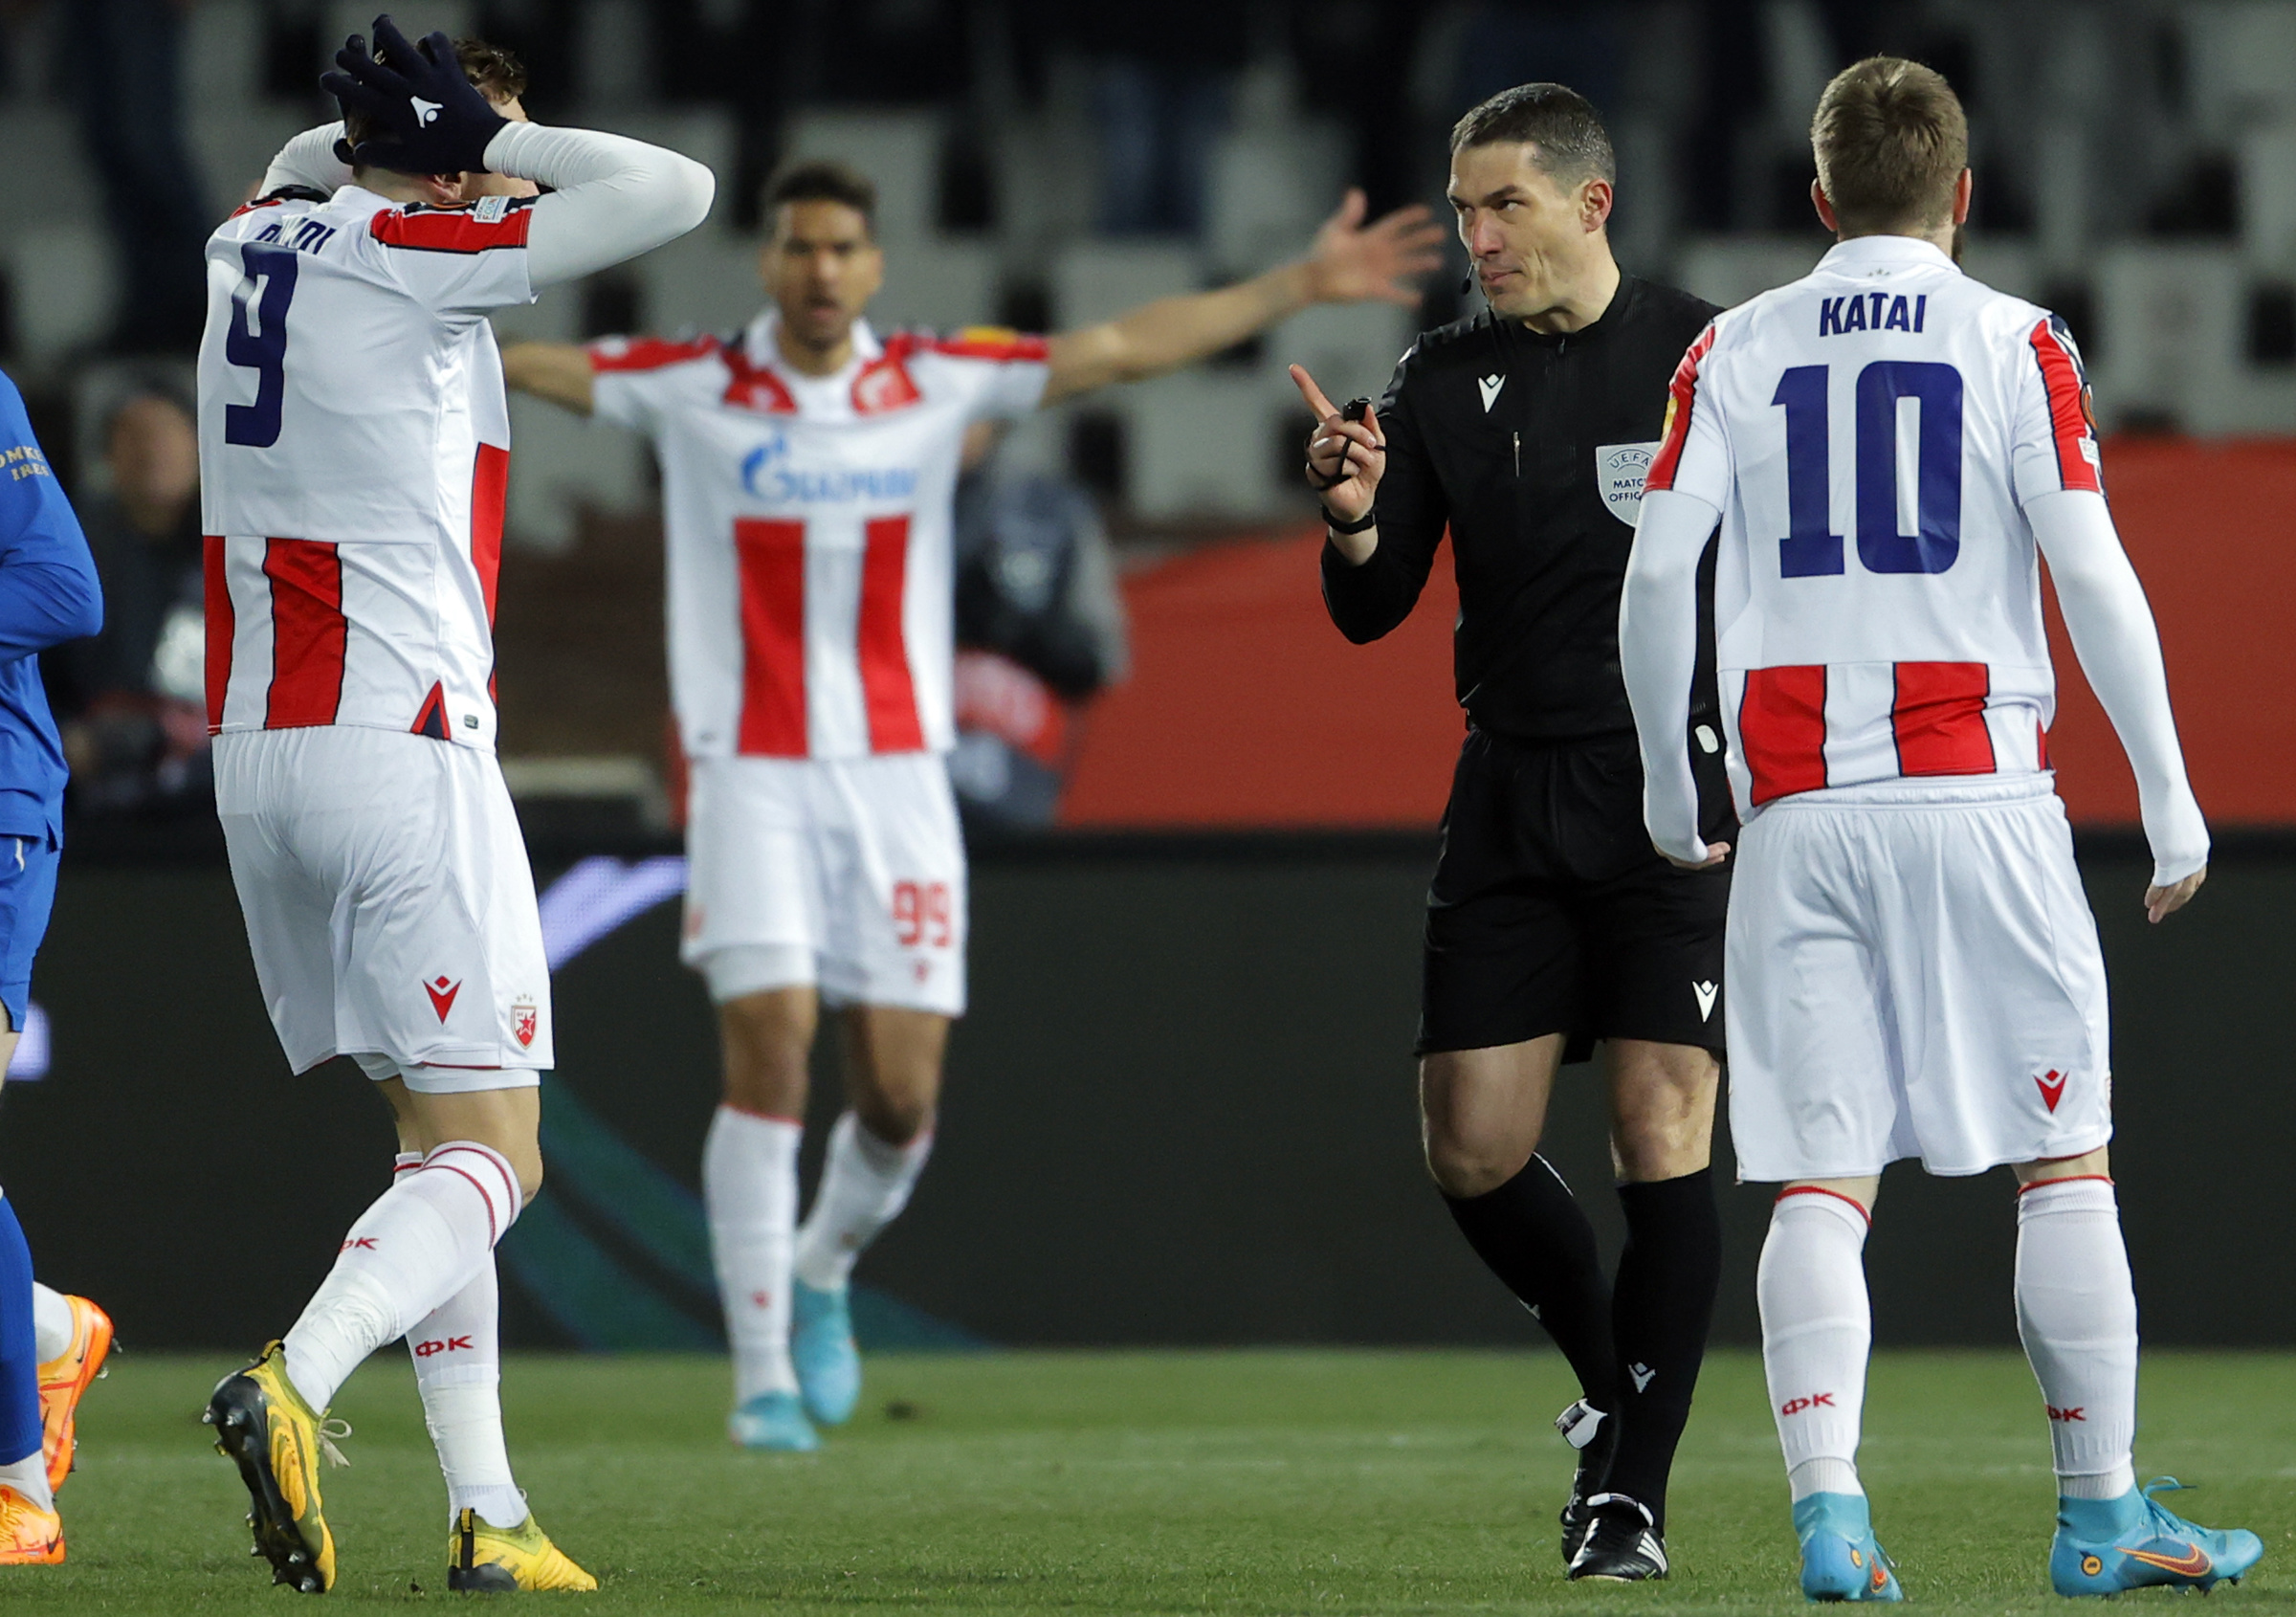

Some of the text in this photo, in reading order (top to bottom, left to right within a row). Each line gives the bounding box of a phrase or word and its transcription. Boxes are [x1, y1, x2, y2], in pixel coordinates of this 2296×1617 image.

[1820, 292, 1927, 337] KATAI
[225, 242, 298, 448] 9
[1609, 453, 1649, 469] UEFA
[1613, 477, 1646, 489] MATC
[1770, 361, 1963, 578] 10
[892, 880, 951, 947] 99
